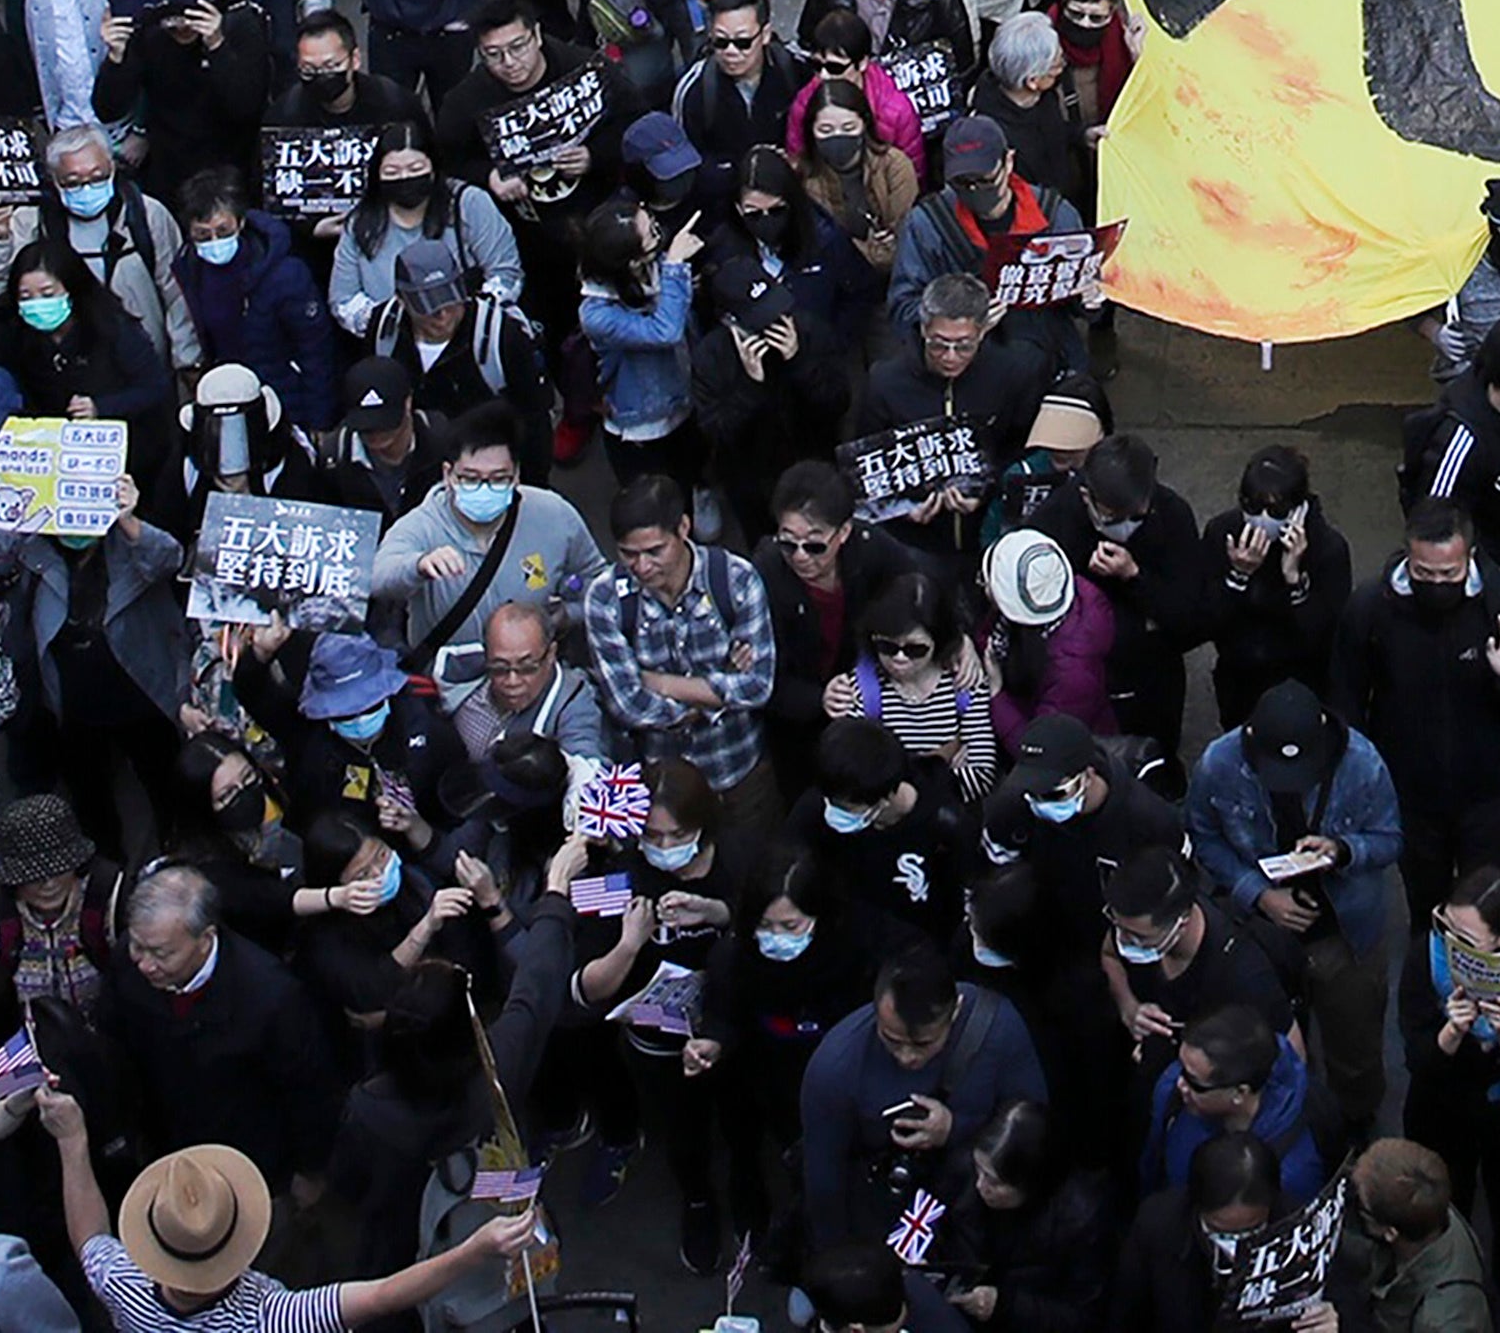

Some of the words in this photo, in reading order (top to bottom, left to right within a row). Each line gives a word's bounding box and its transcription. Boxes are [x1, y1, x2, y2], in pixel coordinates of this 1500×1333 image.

[857, 429, 974, 479] 五大訴求
[219, 515, 359, 561] 五大訴求
